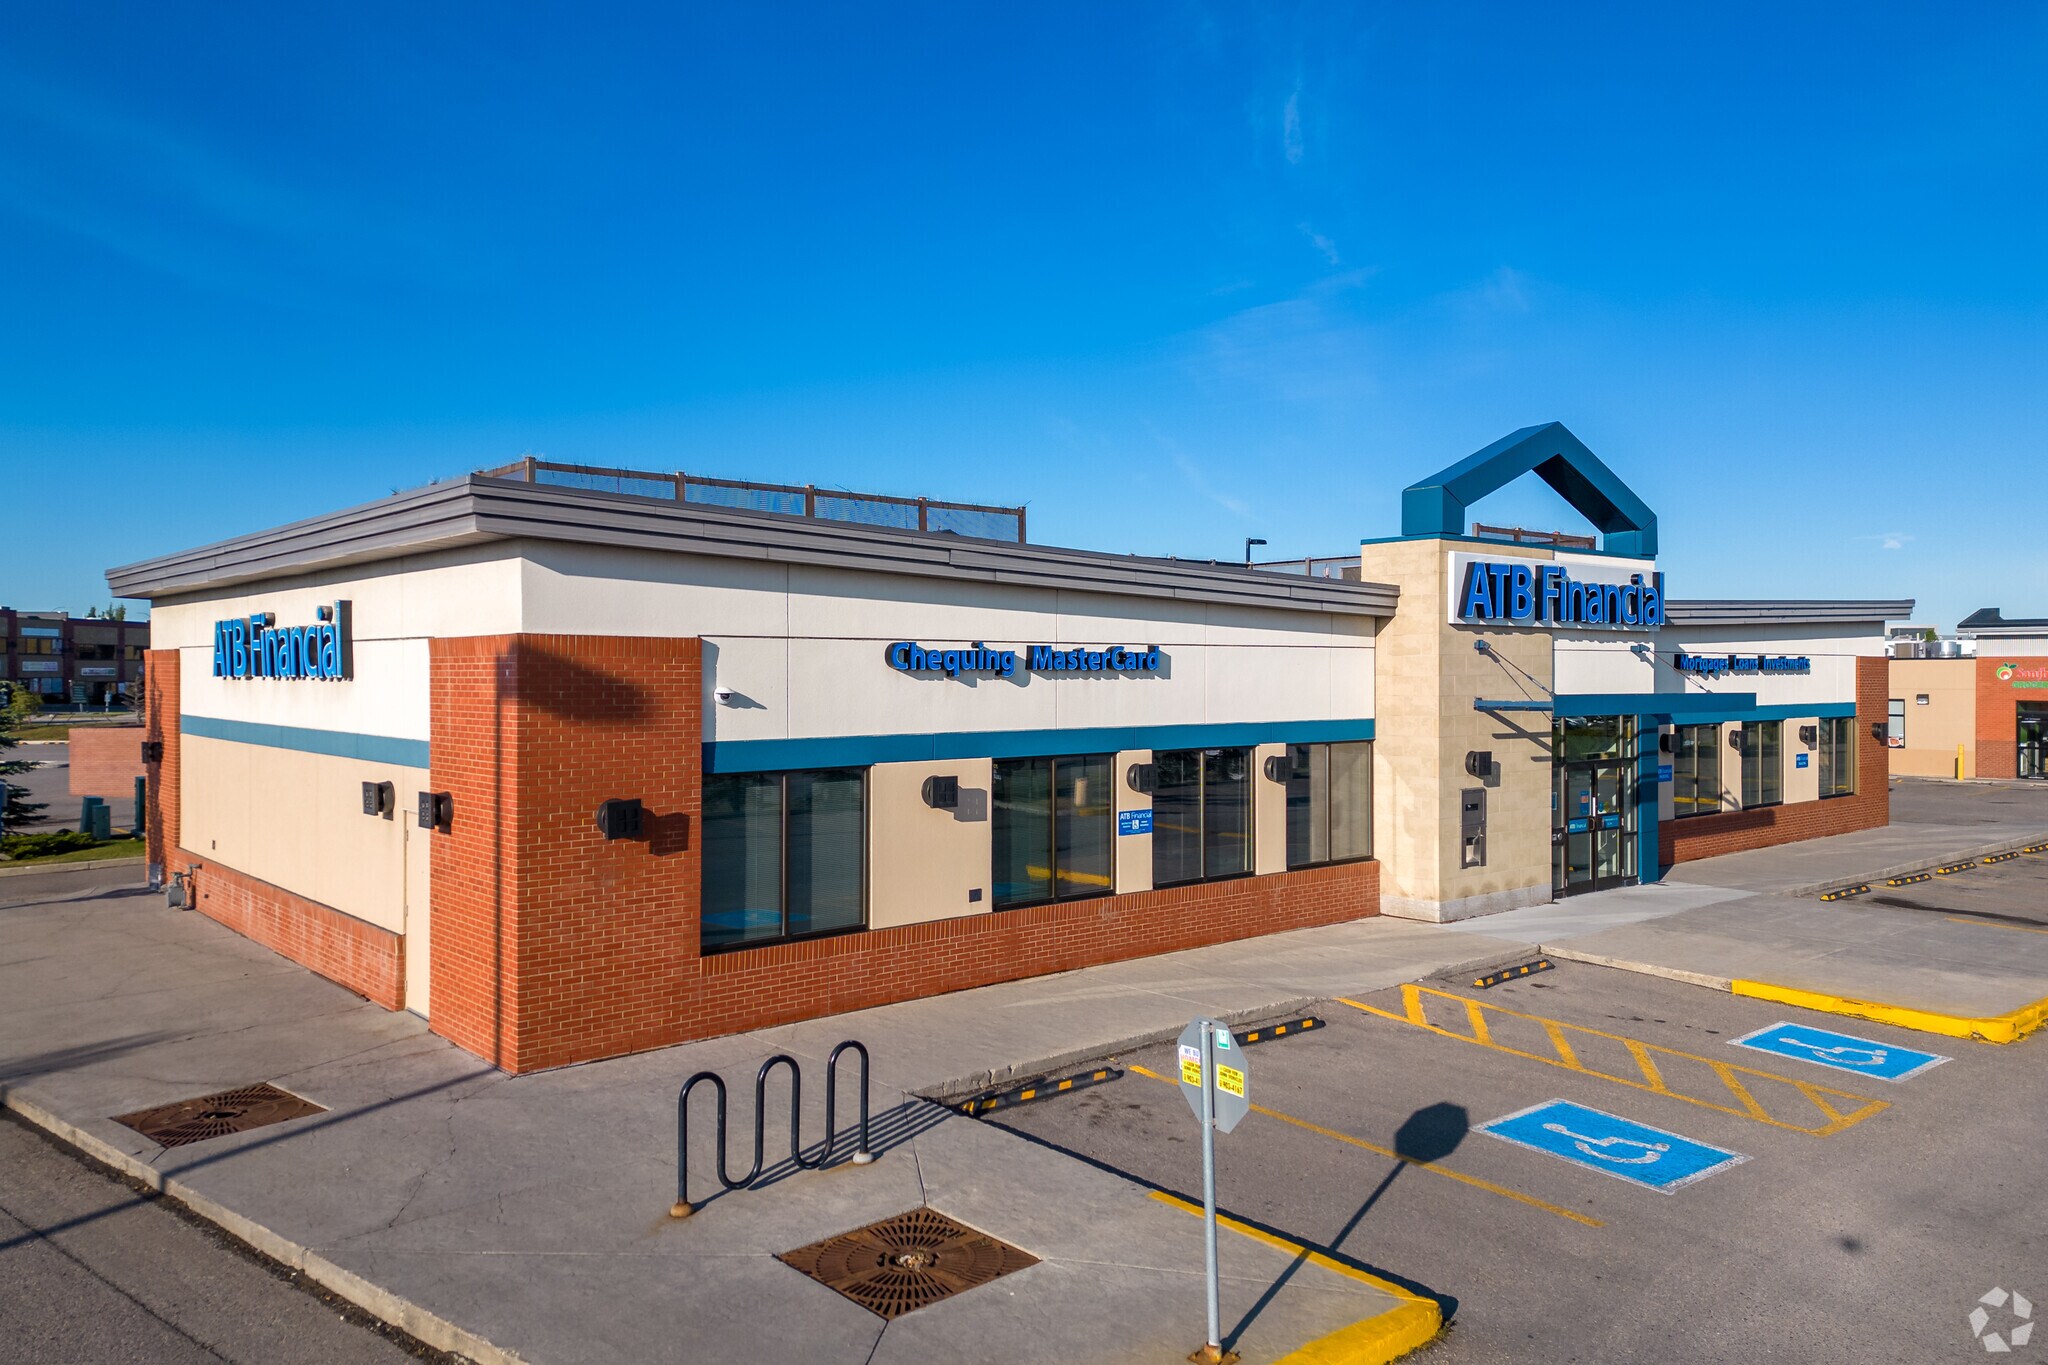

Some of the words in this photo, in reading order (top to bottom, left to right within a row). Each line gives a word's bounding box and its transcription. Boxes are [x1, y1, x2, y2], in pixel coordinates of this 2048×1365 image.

[1460, 561, 1534, 620] ATB
[1539, 565, 1665, 626] Financial
[213, 618, 247, 678] ATB
[249, 599, 348, 679] Financial
[888, 641, 1015, 677] Chequing
[1028, 644, 1160, 671] MasterCard
[1677, 654, 1728, 674] Mortgages
[1731, 655, 1758, 670] Loans
[1761, 656, 1811, 671] Investments
[1131, 811, 1152, 819] Financial
